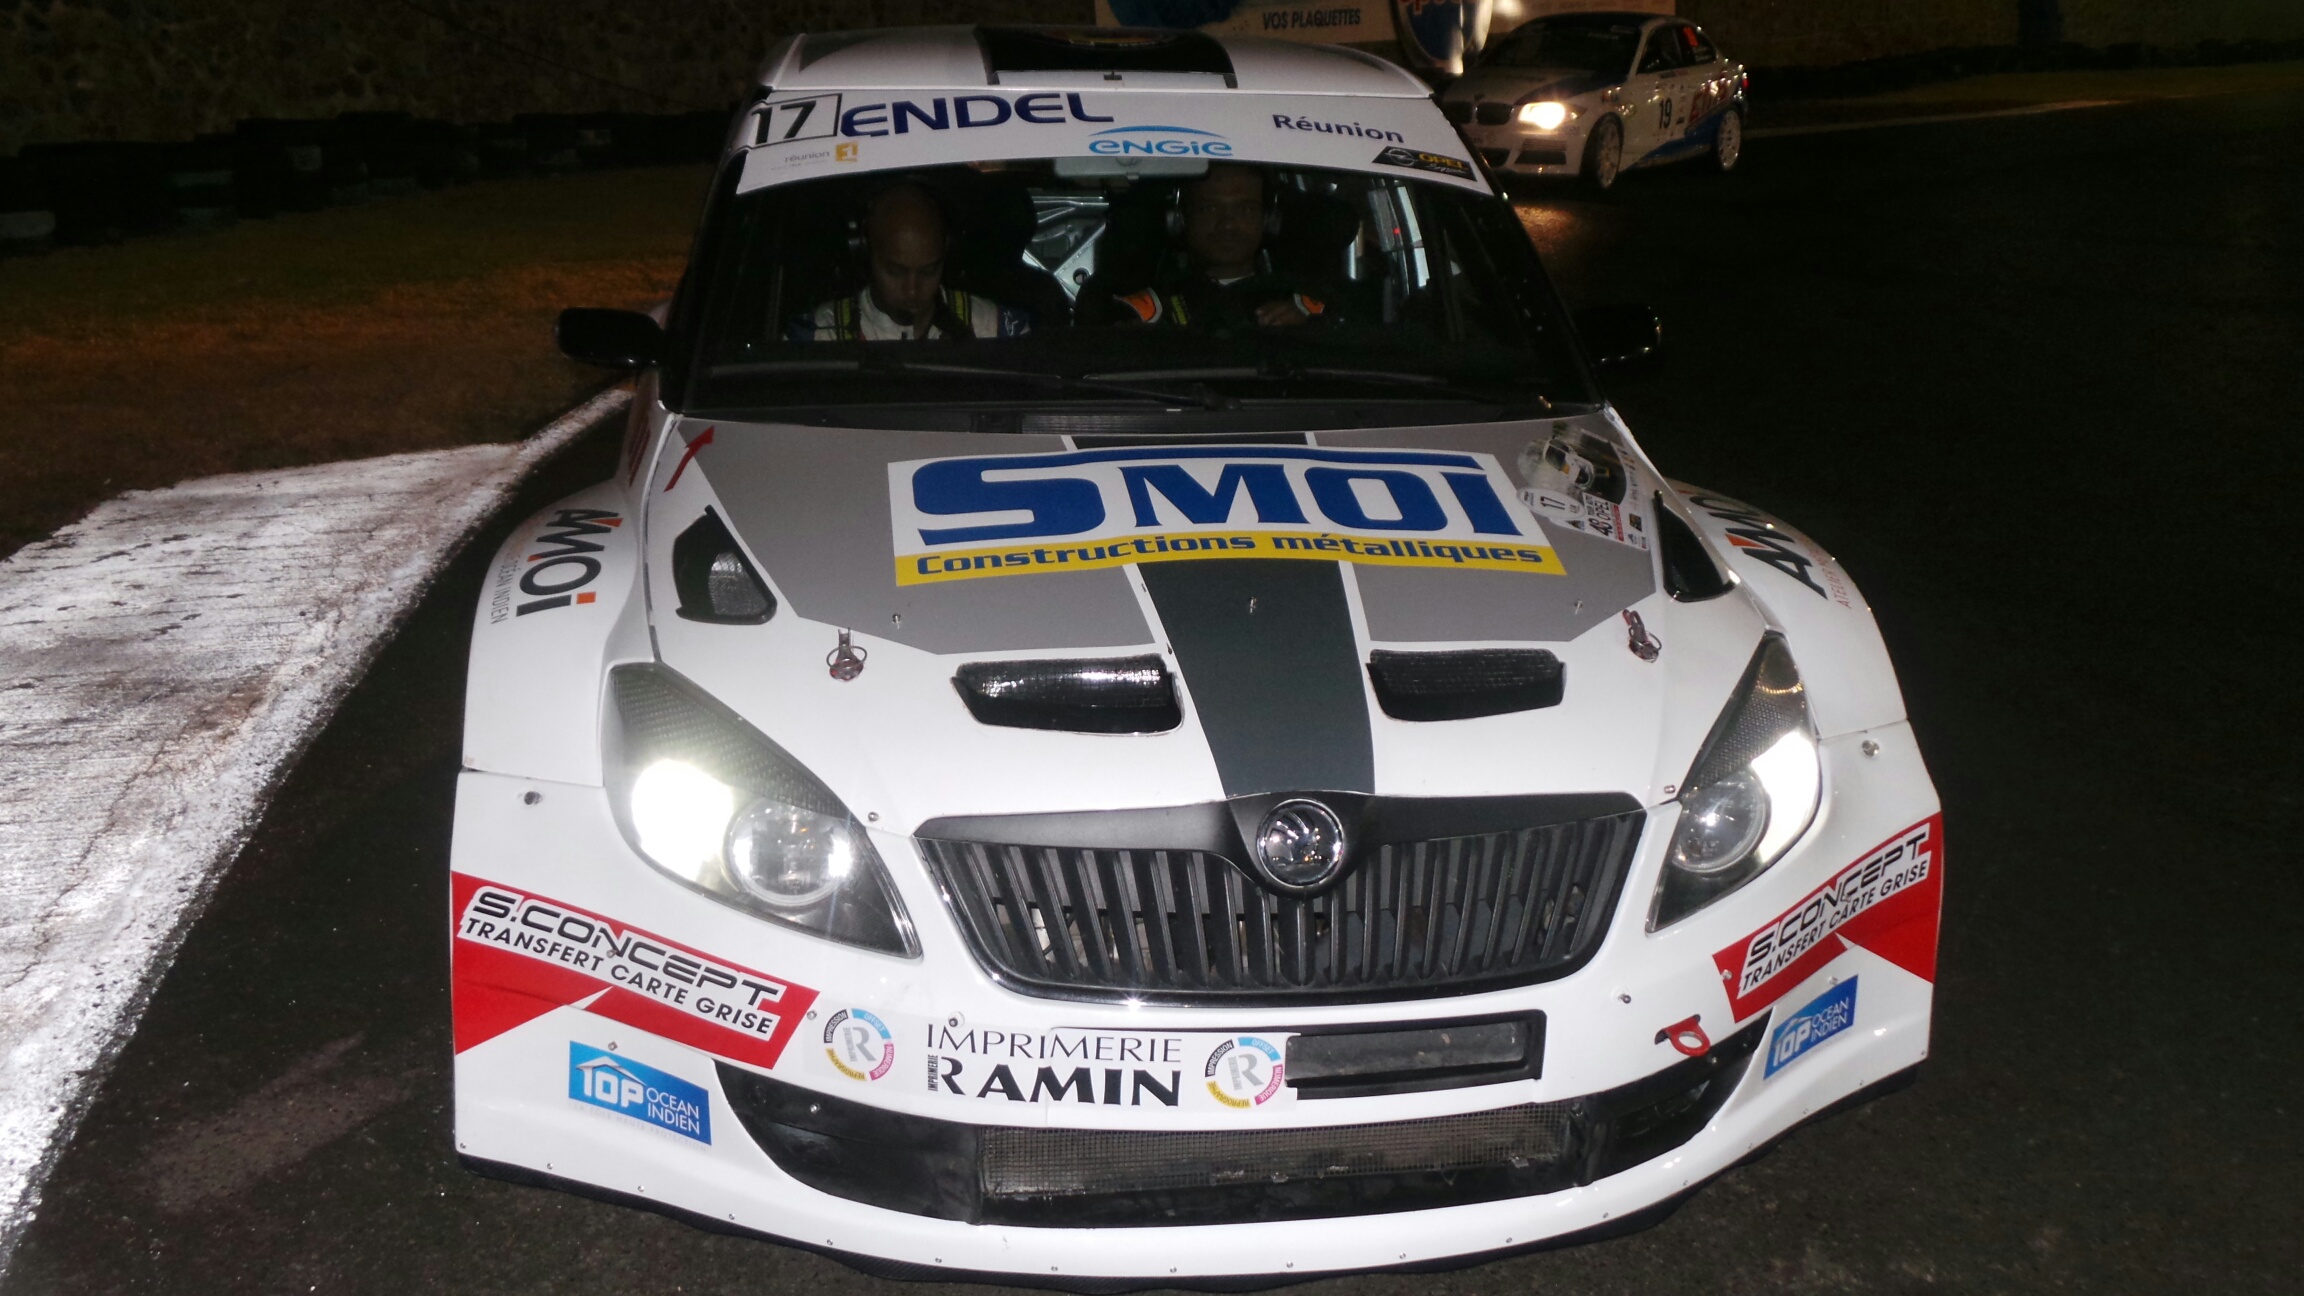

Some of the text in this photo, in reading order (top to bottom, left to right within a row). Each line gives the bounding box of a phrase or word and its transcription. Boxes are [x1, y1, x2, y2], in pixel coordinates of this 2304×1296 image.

[1263, 8, 1361, 30] VOS PLAQUETTES
[751, 100, 817, 145] 17
[840, 92, 1114, 137] ENDEL
[1272, 114, 1404, 143] Réunion
[1659, 97, 1672, 129] 19
[1540, 496, 1566, 510] 17
[917, 534, 1543, 575] Constructions métalliques
[491, 587, 512, 624] INDIEN
[1743, 860, 1927, 991] TRANSFERT CARTE GRISE
[465, 918, 773, 1034] TRANSFERT CARTE GRISE
[826, 1011, 847, 1041] IMPRESSION
[1811, 1014, 1847, 1042] INDIEN
[1812, 997, 1848, 1029] OCEAN
[927, 1024, 1182, 1063] IMPRIMERIE
[1207, 1042, 1232, 1075] IMPRESSION
[941, 1056, 1182, 1106] RAMIN
[646, 1087, 699, 1120] OCEAN
[647, 1102, 700, 1135] INDIEN
